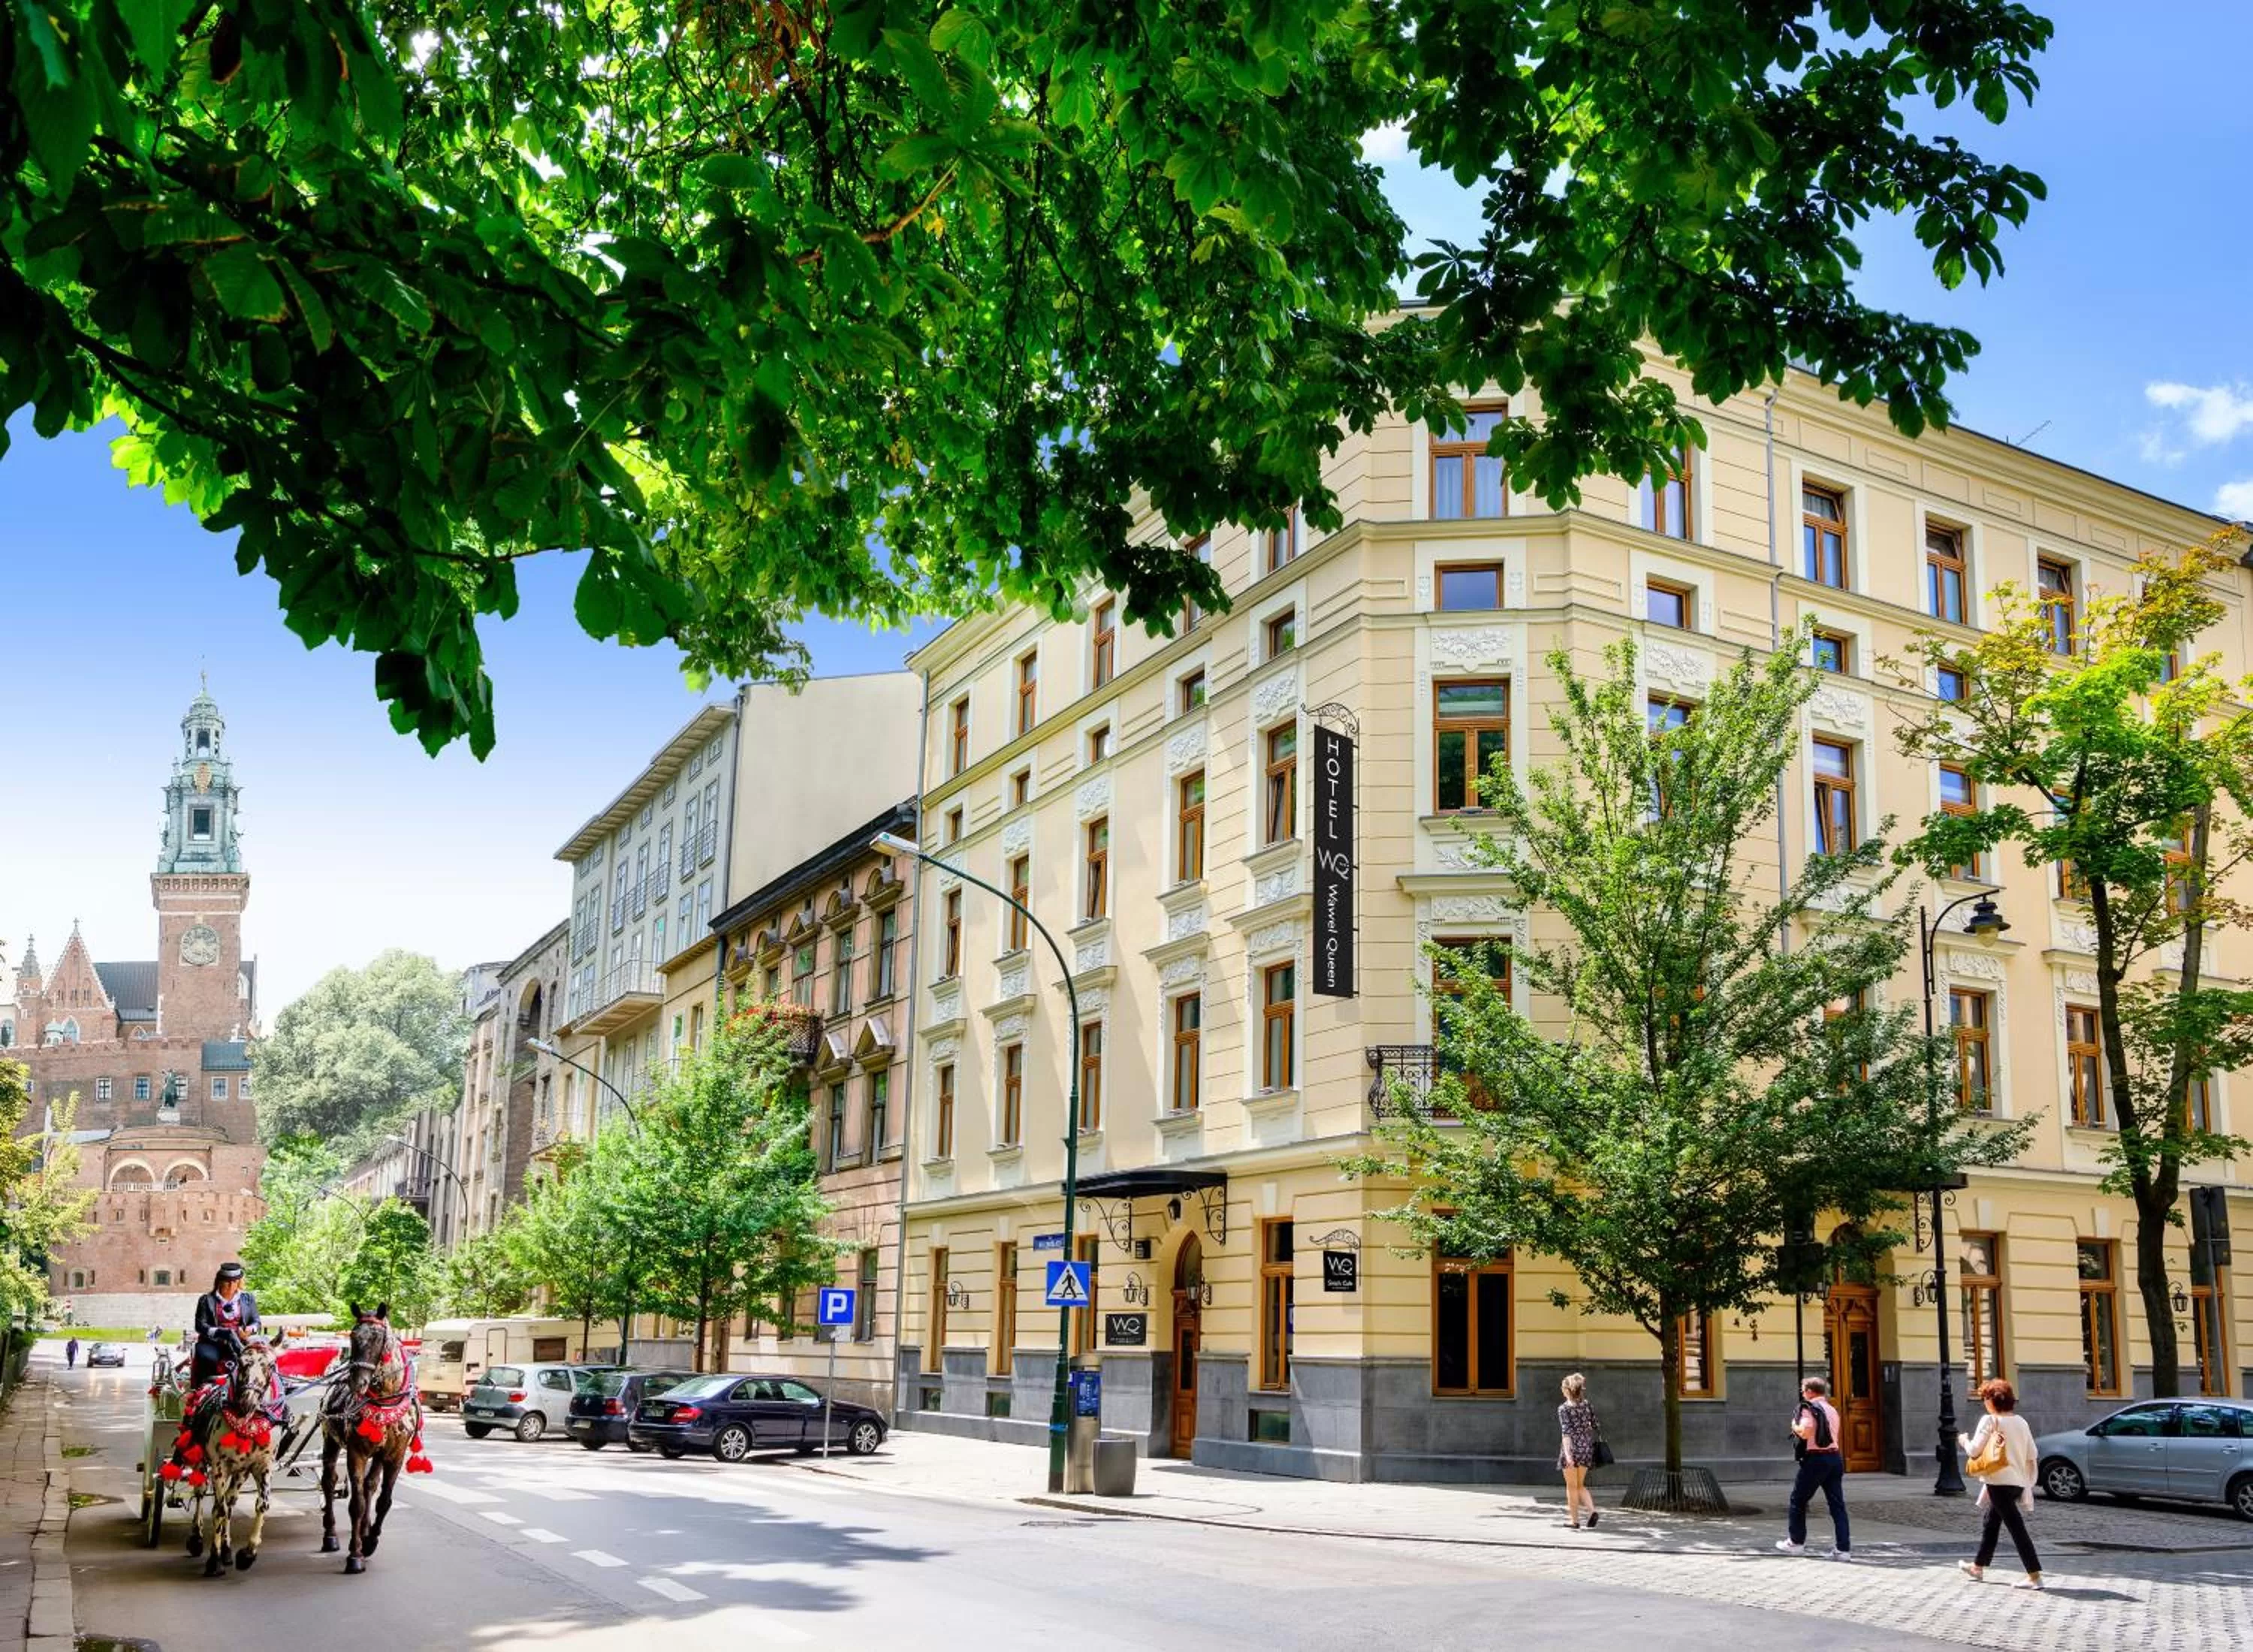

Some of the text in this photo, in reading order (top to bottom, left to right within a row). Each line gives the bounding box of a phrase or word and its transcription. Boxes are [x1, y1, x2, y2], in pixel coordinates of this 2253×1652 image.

[1326, 736, 1340, 840] HOTEL
[1326, 884, 1338, 987] Wawel Queen
[827, 1292, 848, 1321] P
